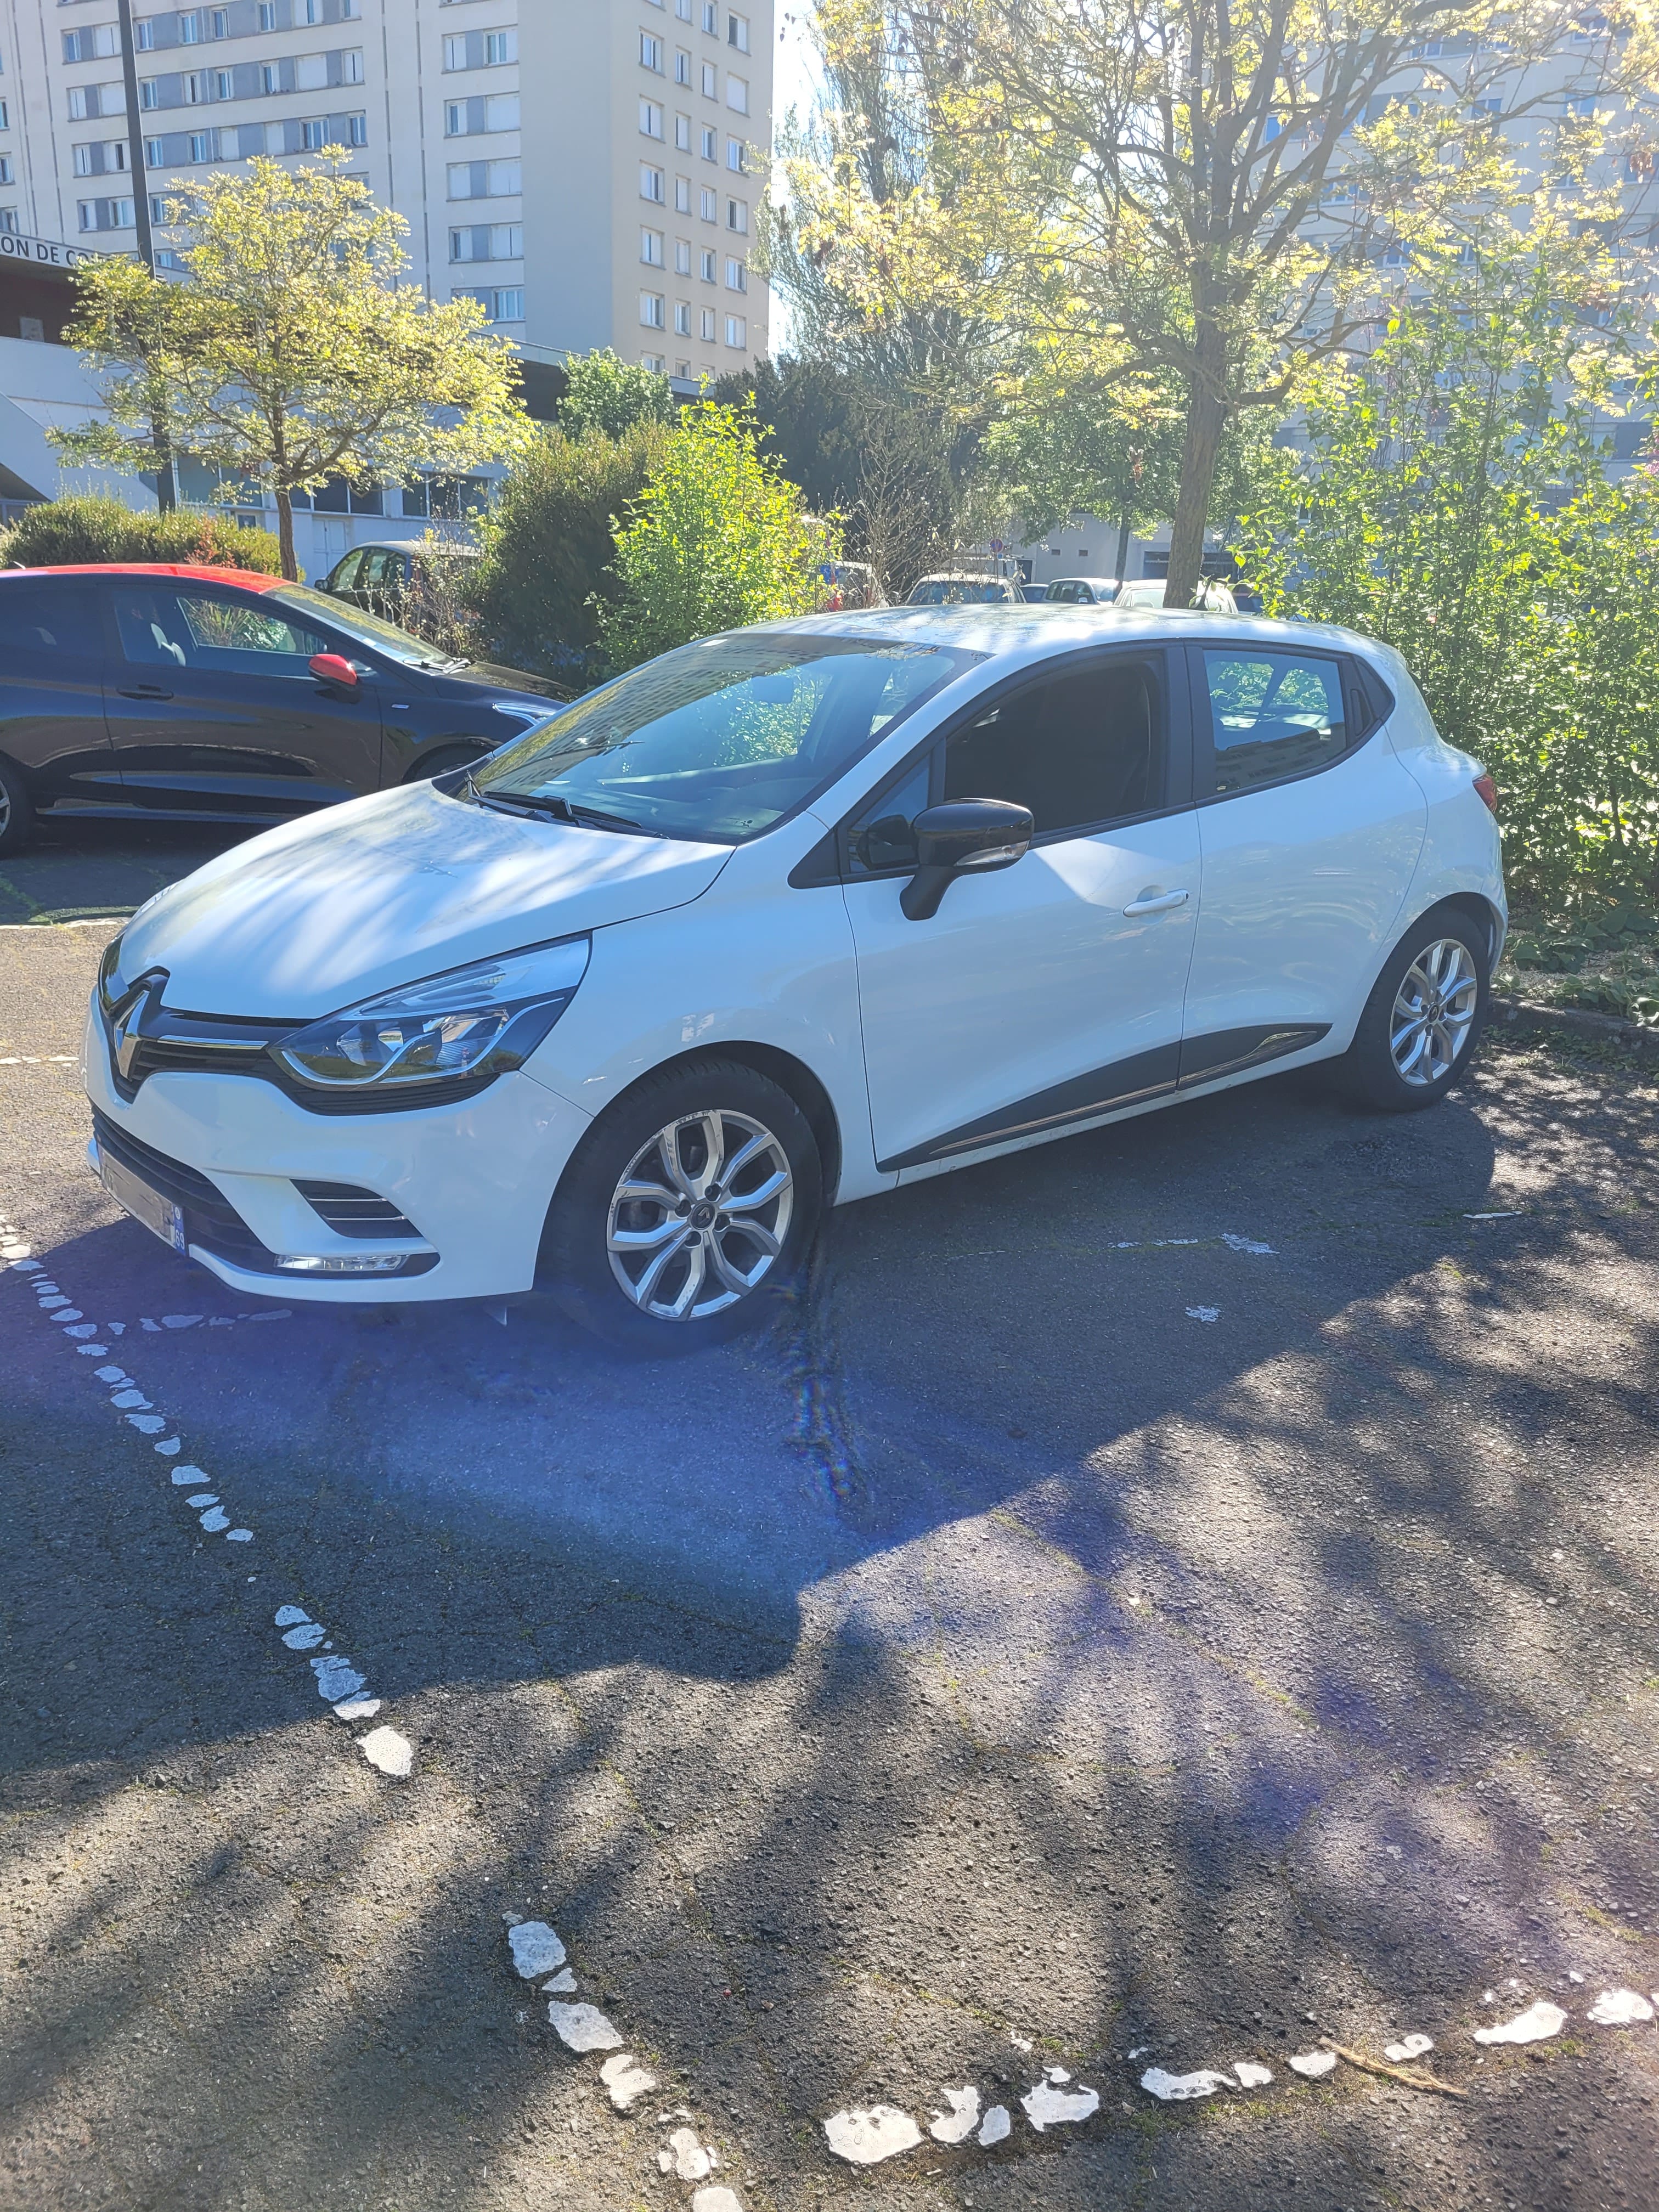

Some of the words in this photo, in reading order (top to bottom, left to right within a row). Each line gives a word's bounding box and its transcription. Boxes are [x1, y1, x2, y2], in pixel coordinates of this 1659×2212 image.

[0, 236, 29, 257] ON
[36, 244, 60, 263] DE
[66, 250, 97, 269] CO
[176, 1229, 185, 1250] 69
